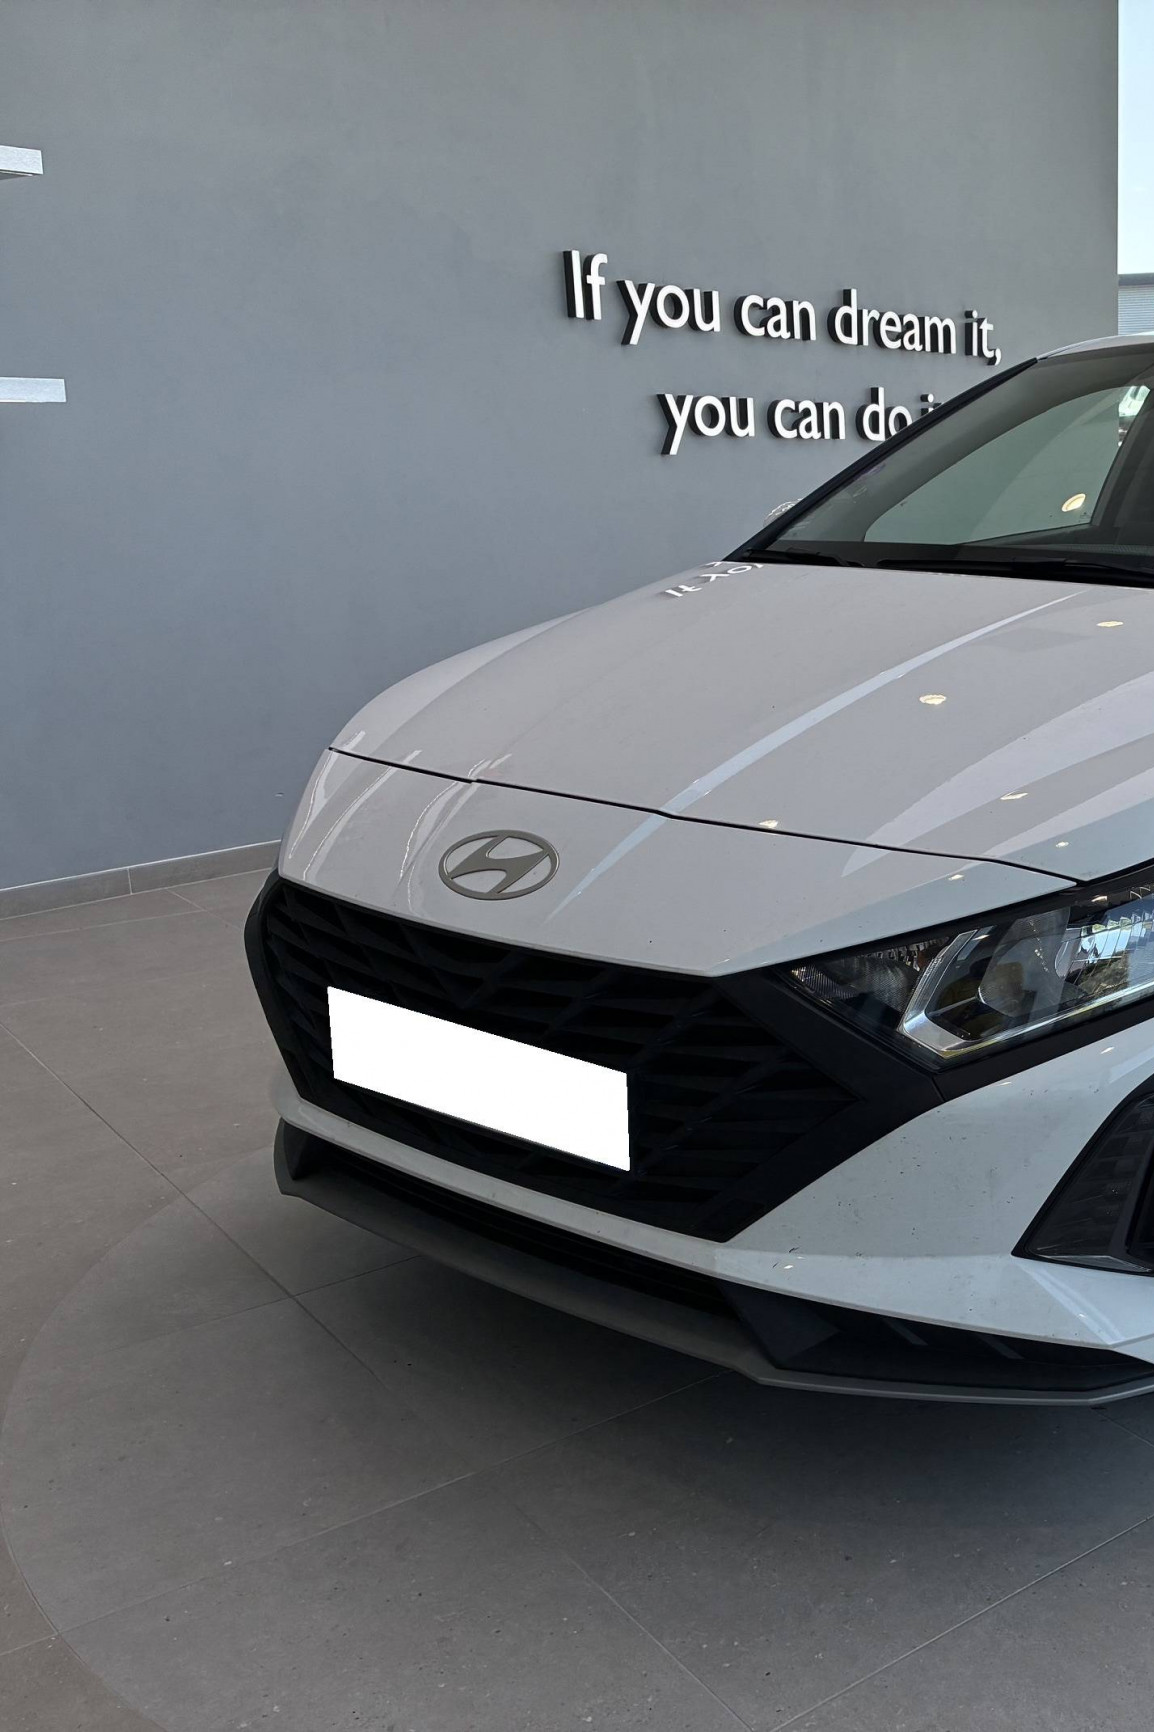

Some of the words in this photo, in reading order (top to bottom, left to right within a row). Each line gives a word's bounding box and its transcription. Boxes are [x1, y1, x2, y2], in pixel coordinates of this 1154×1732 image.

[563, 250, 608, 320] If
[616, 279, 721, 345] you
[734, 294, 816, 341] can
[828, 288, 956, 356] dream
[965, 310, 1002, 366] it,
[657, 393, 755, 455] you
[767, 398, 845, 440] can
[856, 386, 913, 442] do
